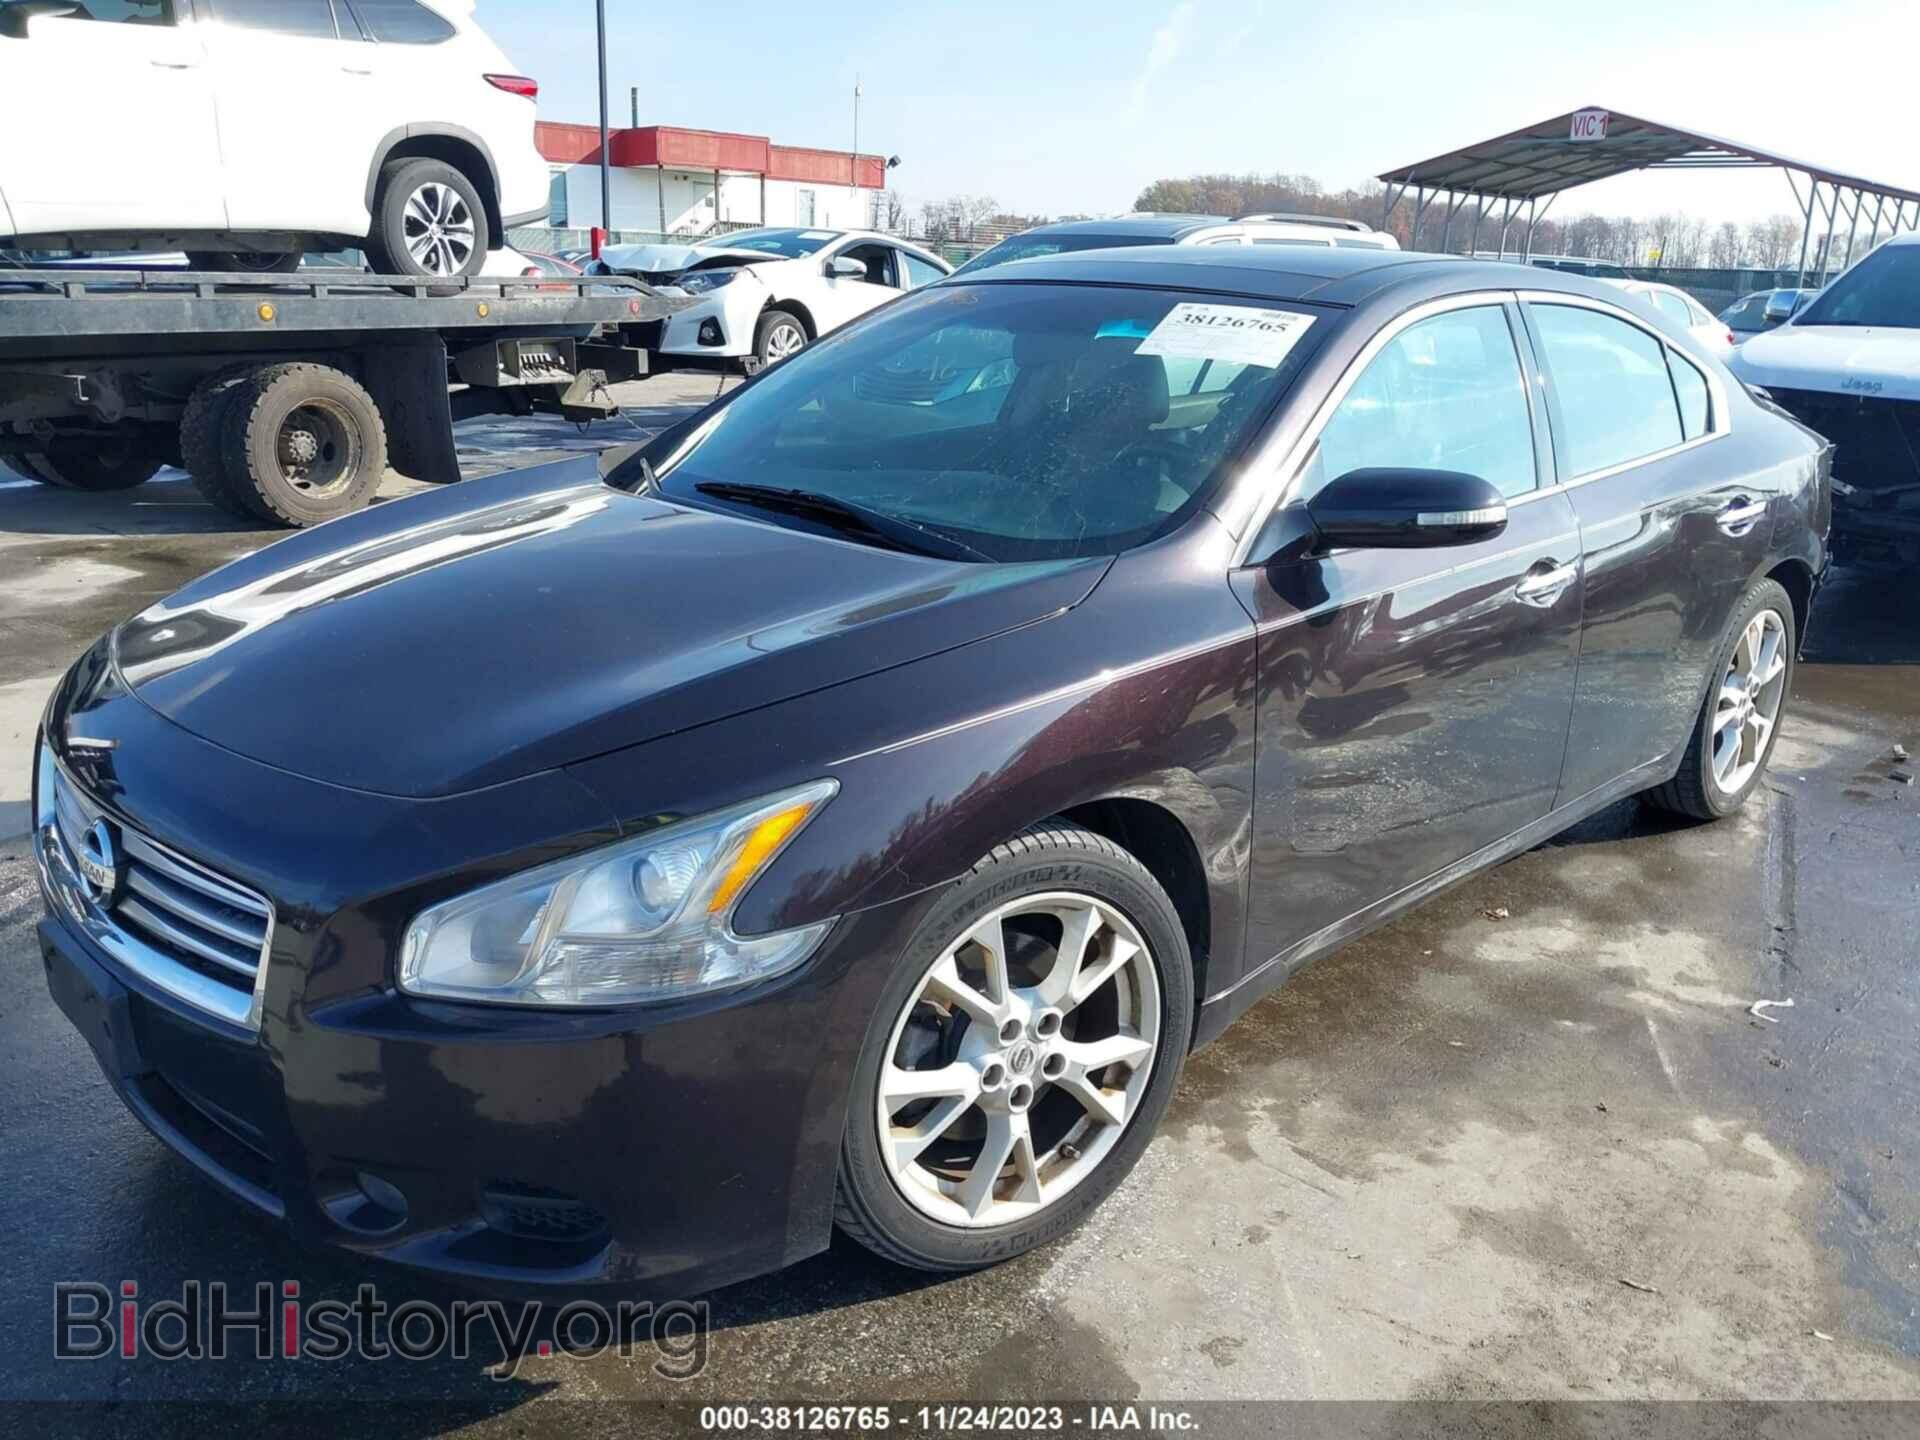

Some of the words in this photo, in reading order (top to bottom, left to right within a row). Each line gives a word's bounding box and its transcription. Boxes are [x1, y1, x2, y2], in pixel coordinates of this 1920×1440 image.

[1574, 115, 1597, 137] VIC
[1599, 115, 1608, 136] 1
[1177, 312, 1289, 333] 38126765
